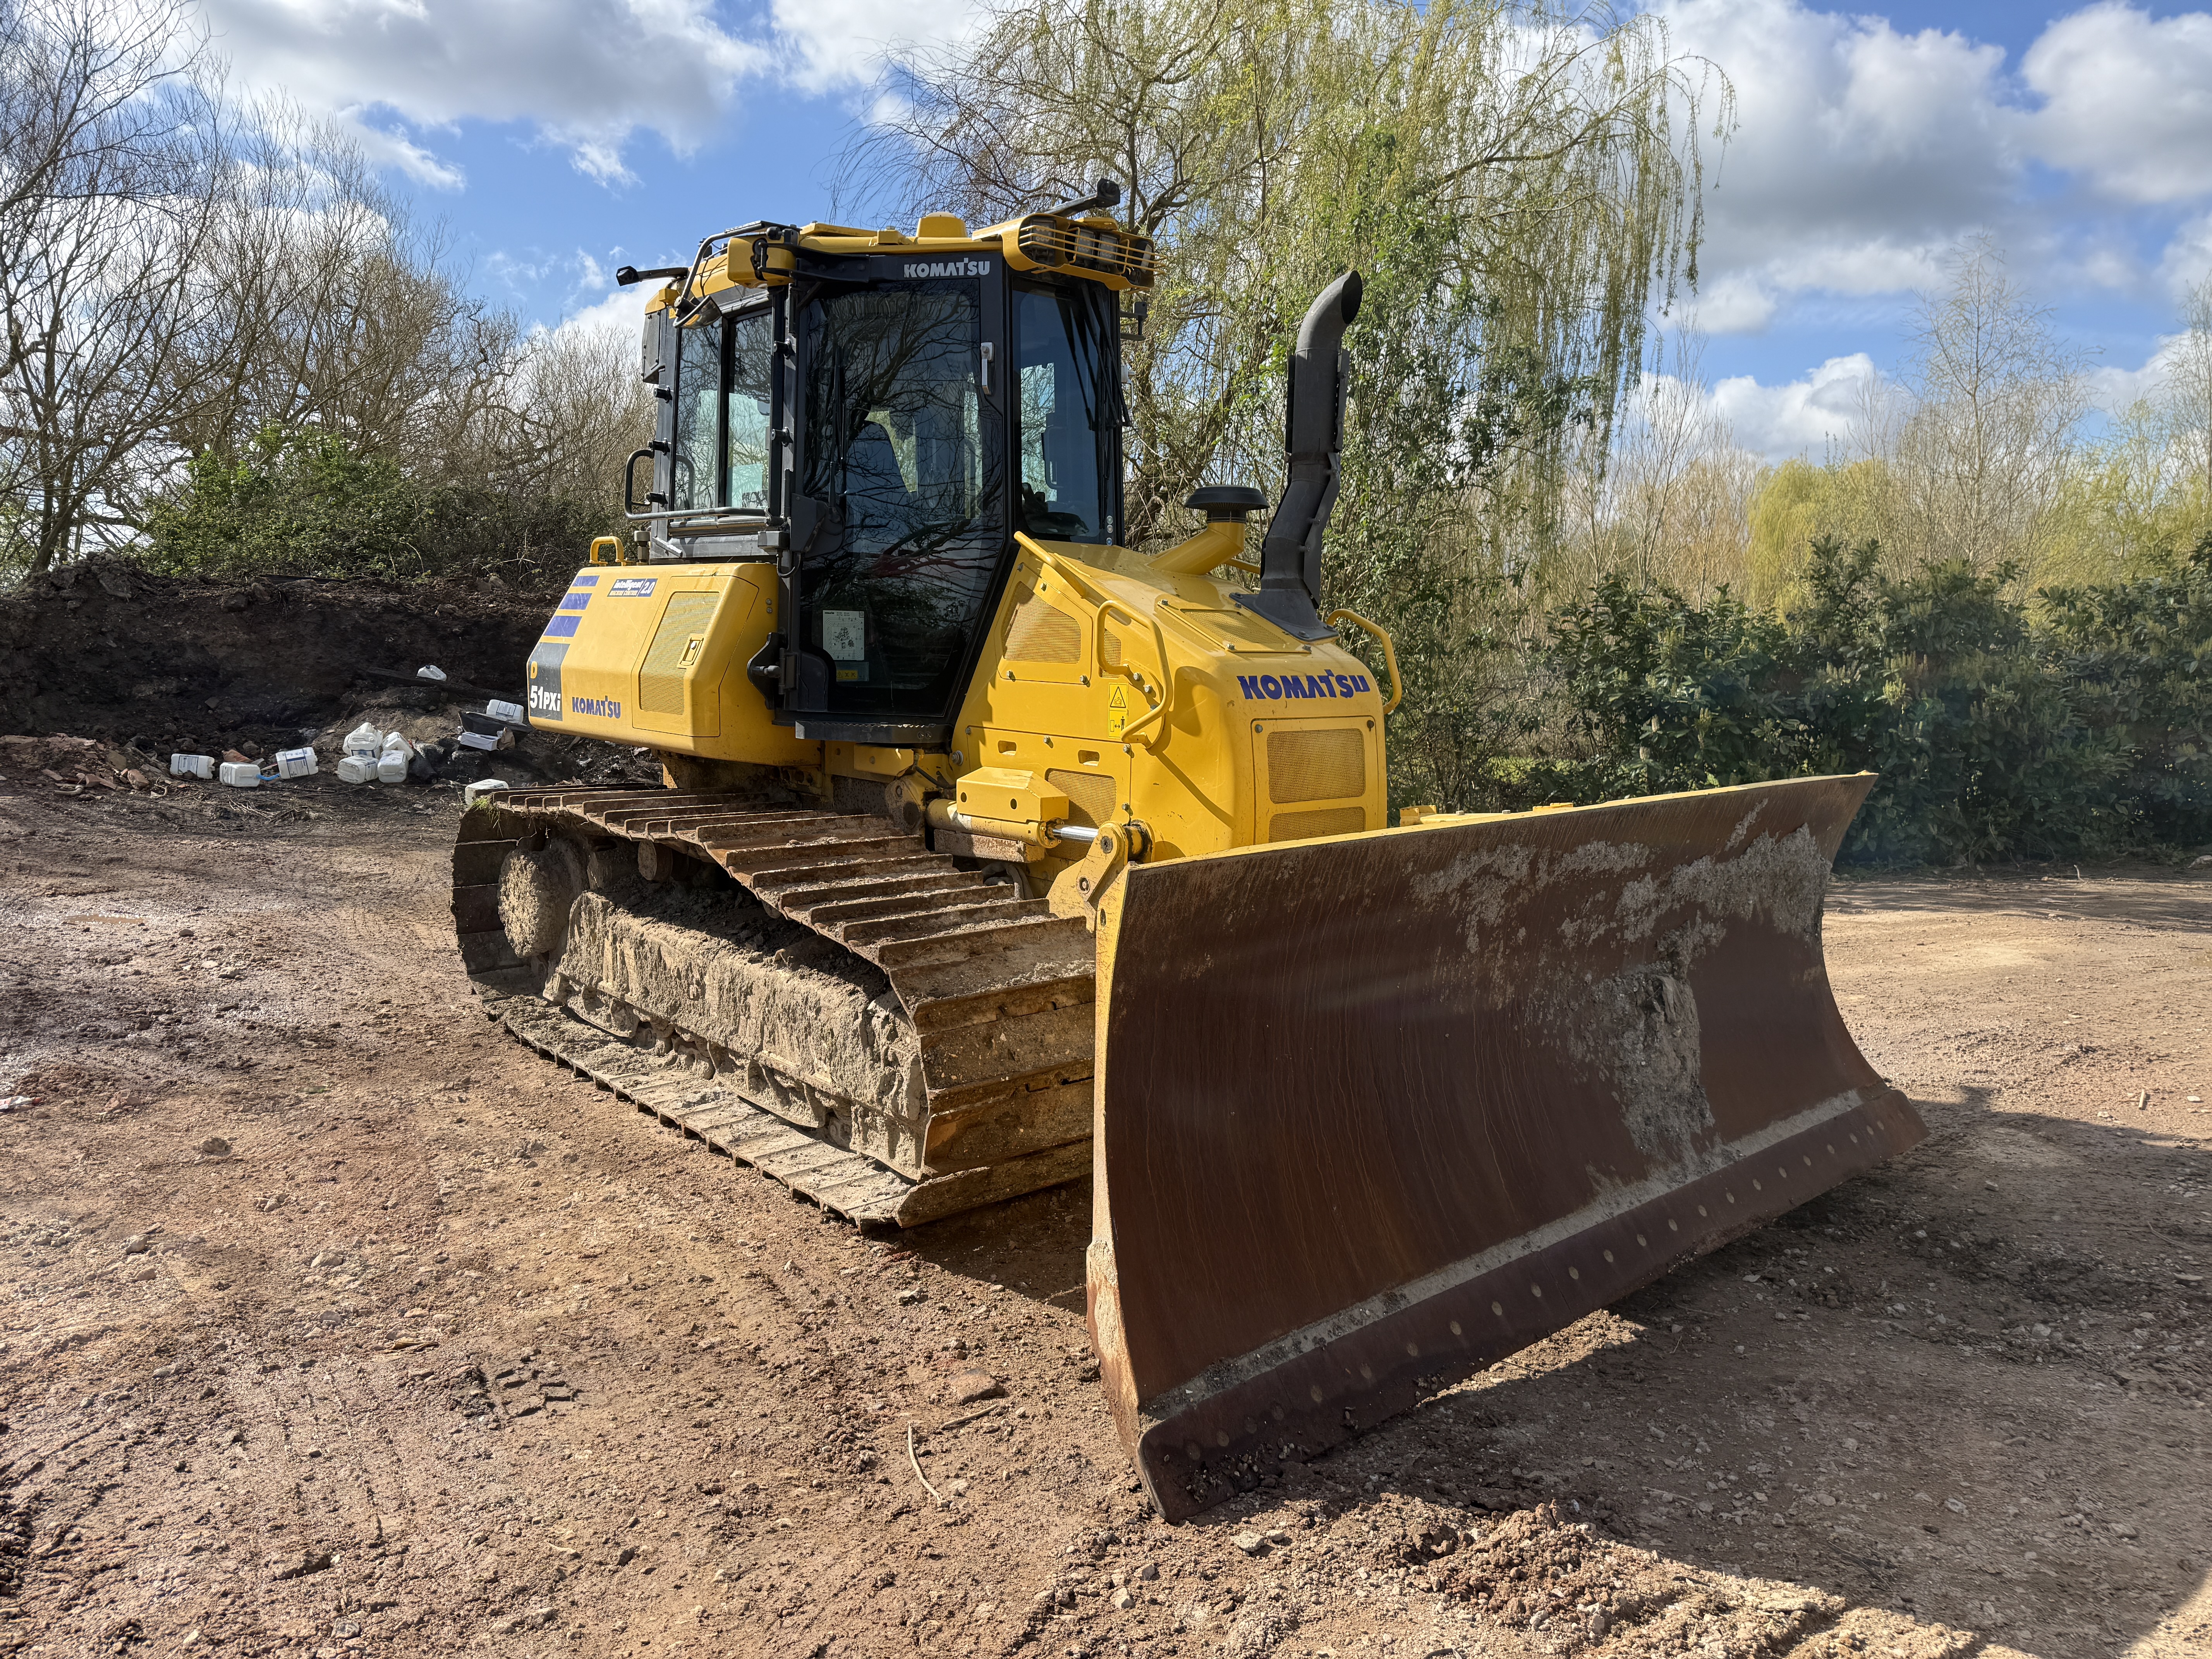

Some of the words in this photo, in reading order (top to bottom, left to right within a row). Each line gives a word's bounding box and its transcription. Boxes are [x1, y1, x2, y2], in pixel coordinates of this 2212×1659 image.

[904, 258, 990, 278] KOMATSU
[613, 580, 644, 591] intelligent
[640, 582, 656, 594] 2.0
[530, 661, 538, 679] D
[1236, 669, 1370, 700] KOMATSU
[530, 685, 561, 711] 51PXi
[572, 696, 621, 719] KOMATSU
